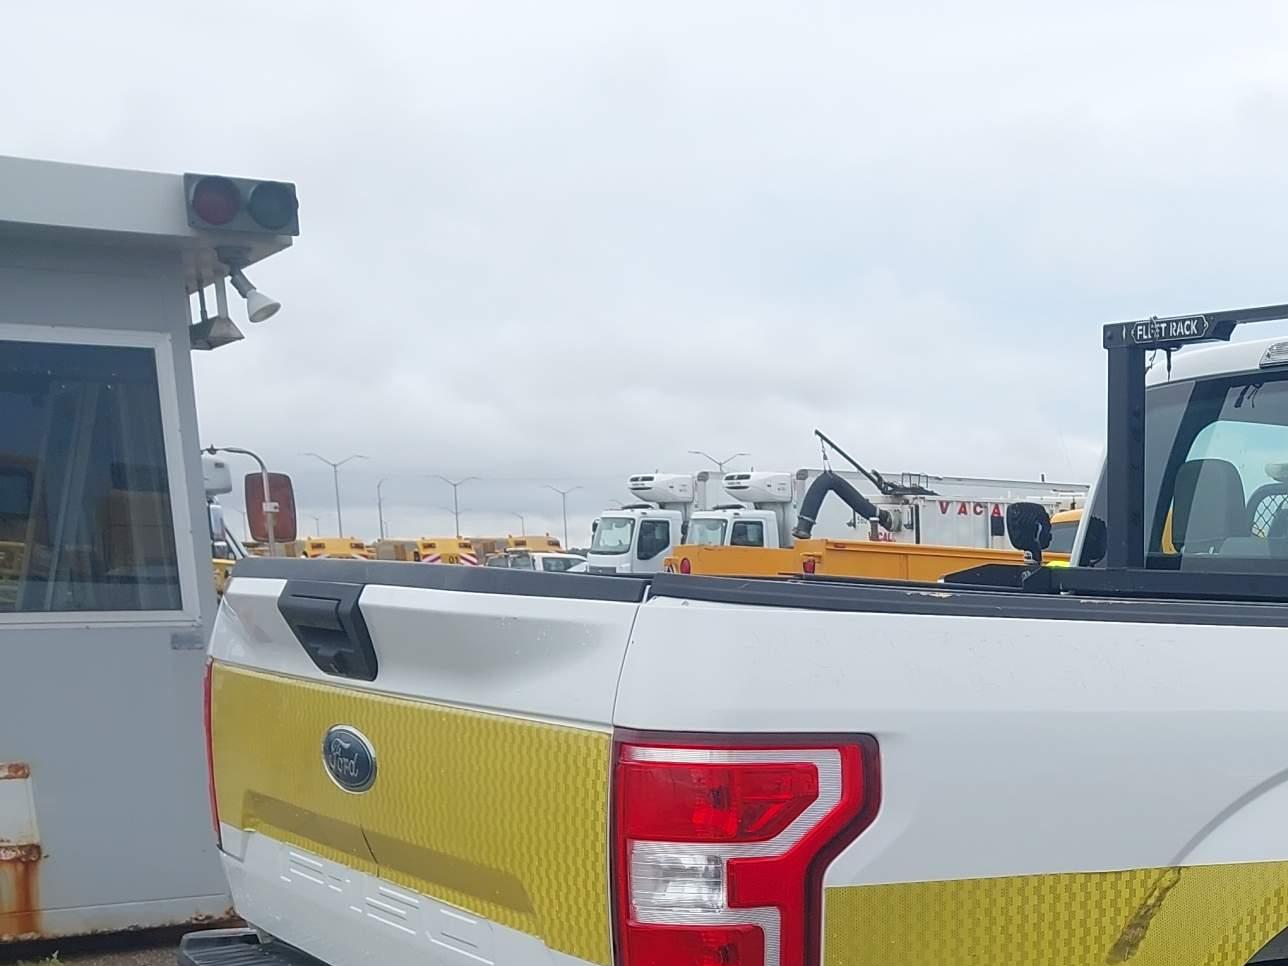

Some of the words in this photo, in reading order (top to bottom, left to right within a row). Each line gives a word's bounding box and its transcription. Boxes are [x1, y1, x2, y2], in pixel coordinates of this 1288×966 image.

[1170, 320, 1198, 337] RACK
[939, 501, 1002, 517] VACA
[328, 737, 359, 777] Ford
